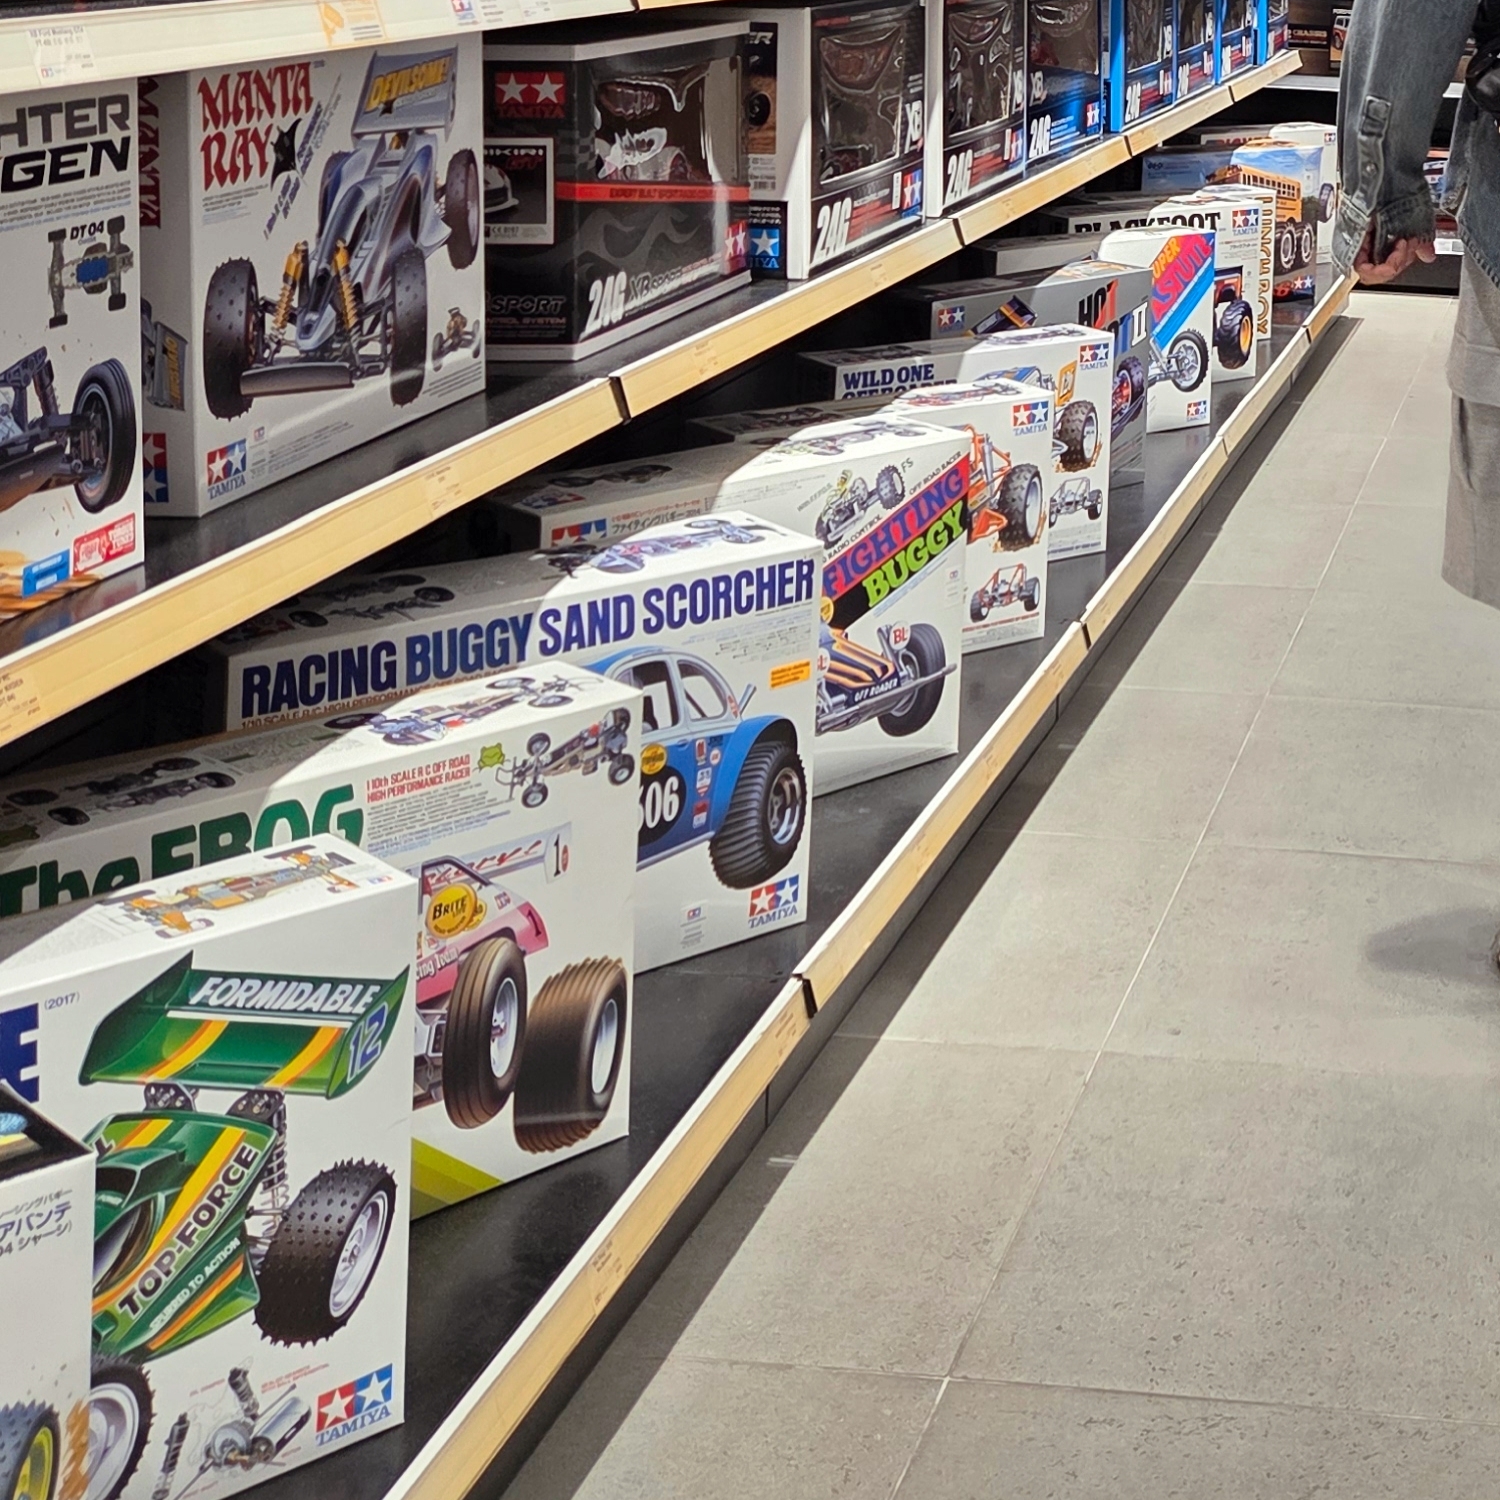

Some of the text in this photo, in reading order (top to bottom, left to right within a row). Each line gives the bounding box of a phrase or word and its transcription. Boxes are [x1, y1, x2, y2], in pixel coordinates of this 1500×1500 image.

[197, 62, 314, 132] MANTA
[200, 124, 273, 191] RAY
[1078, 278, 1119, 330] HOT
[843, 364, 934, 391] WILD ONE
[1080, 361, 1109, 371] TAMIYA
[1013, 424, 1048, 436] TAMIYA
[207, 477, 247, 501] TAMIYA
[822, 467, 964, 599] FIGHTING
[862, 500, 964, 608] BUGGY
[241, 640, 397, 719] RACING
[405, 612, 533, 686] BUGGY
[538, 594, 636, 657] SAND
[642, 558, 815, 636] SCORCHER
[869, 676, 898, 696] ROADER
[367, 766, 470, 803] HIGH PERFORMANCE RACER
[391, 754, 470, 785] SCALE OFF ROAD
[0, 856, 141, 917] The
[150, 784, 364, 884] FROG
[432, 894, 469, 920] BRITE
[748, 904, 798, 929] TAMIYA
[44, 991, 80, 1011] (2017)
[188, 976, 381, 1015] FORMIDABLE
[347, 1002, 388, 1085] 12
[117, 1146, 259, 1318] TOP-FORCE
[190, 1272, 205, 1292] TO
[204, 1238, 241, 1277] ACTION
[315, 1405, 392, 1446] TAMIYA
